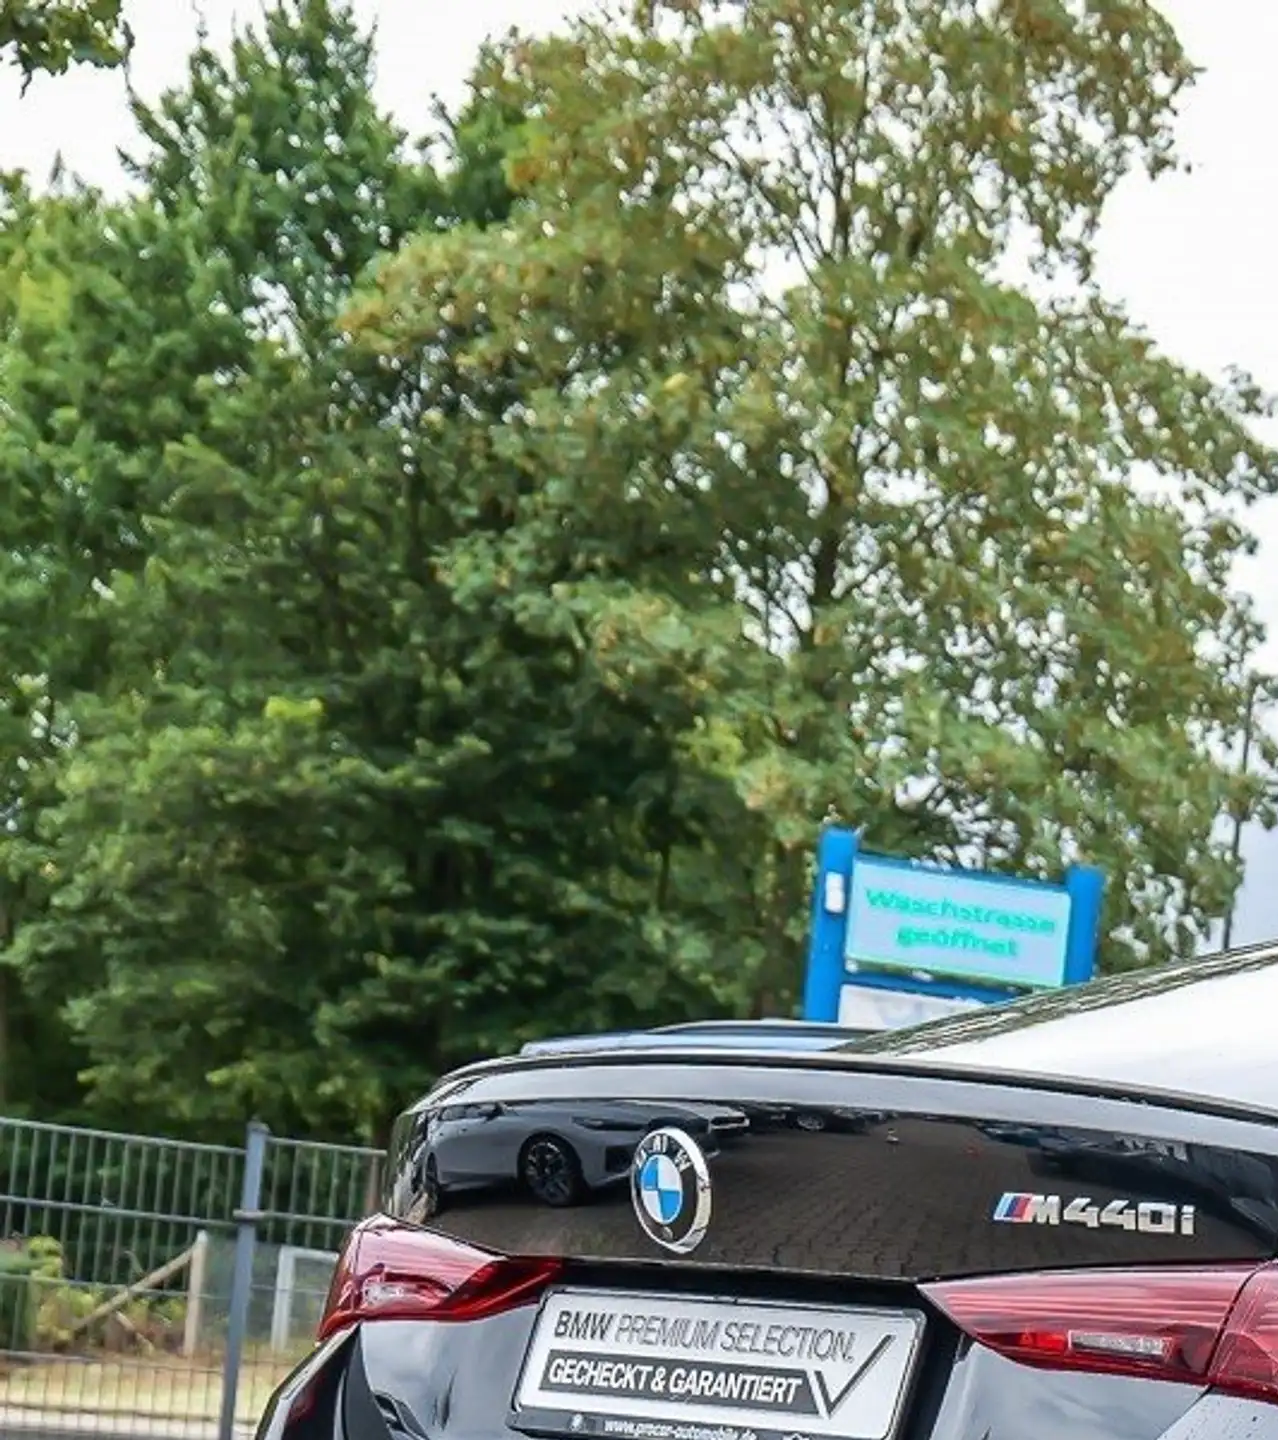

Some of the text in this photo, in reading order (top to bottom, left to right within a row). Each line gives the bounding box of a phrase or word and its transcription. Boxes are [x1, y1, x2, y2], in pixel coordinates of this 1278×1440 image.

[864, 887, 1055, 933] Waschstrasse
[895, 925, 1018, 956] geöffnet
[1026, 1194, 1196, 1236] M440i
[554, 1310, 614, 1342] BMW
[615, 1314, 724, 1350] PREMIUM
[549, 1357, 803, 1405] GECHECKT & GARANTIERT
